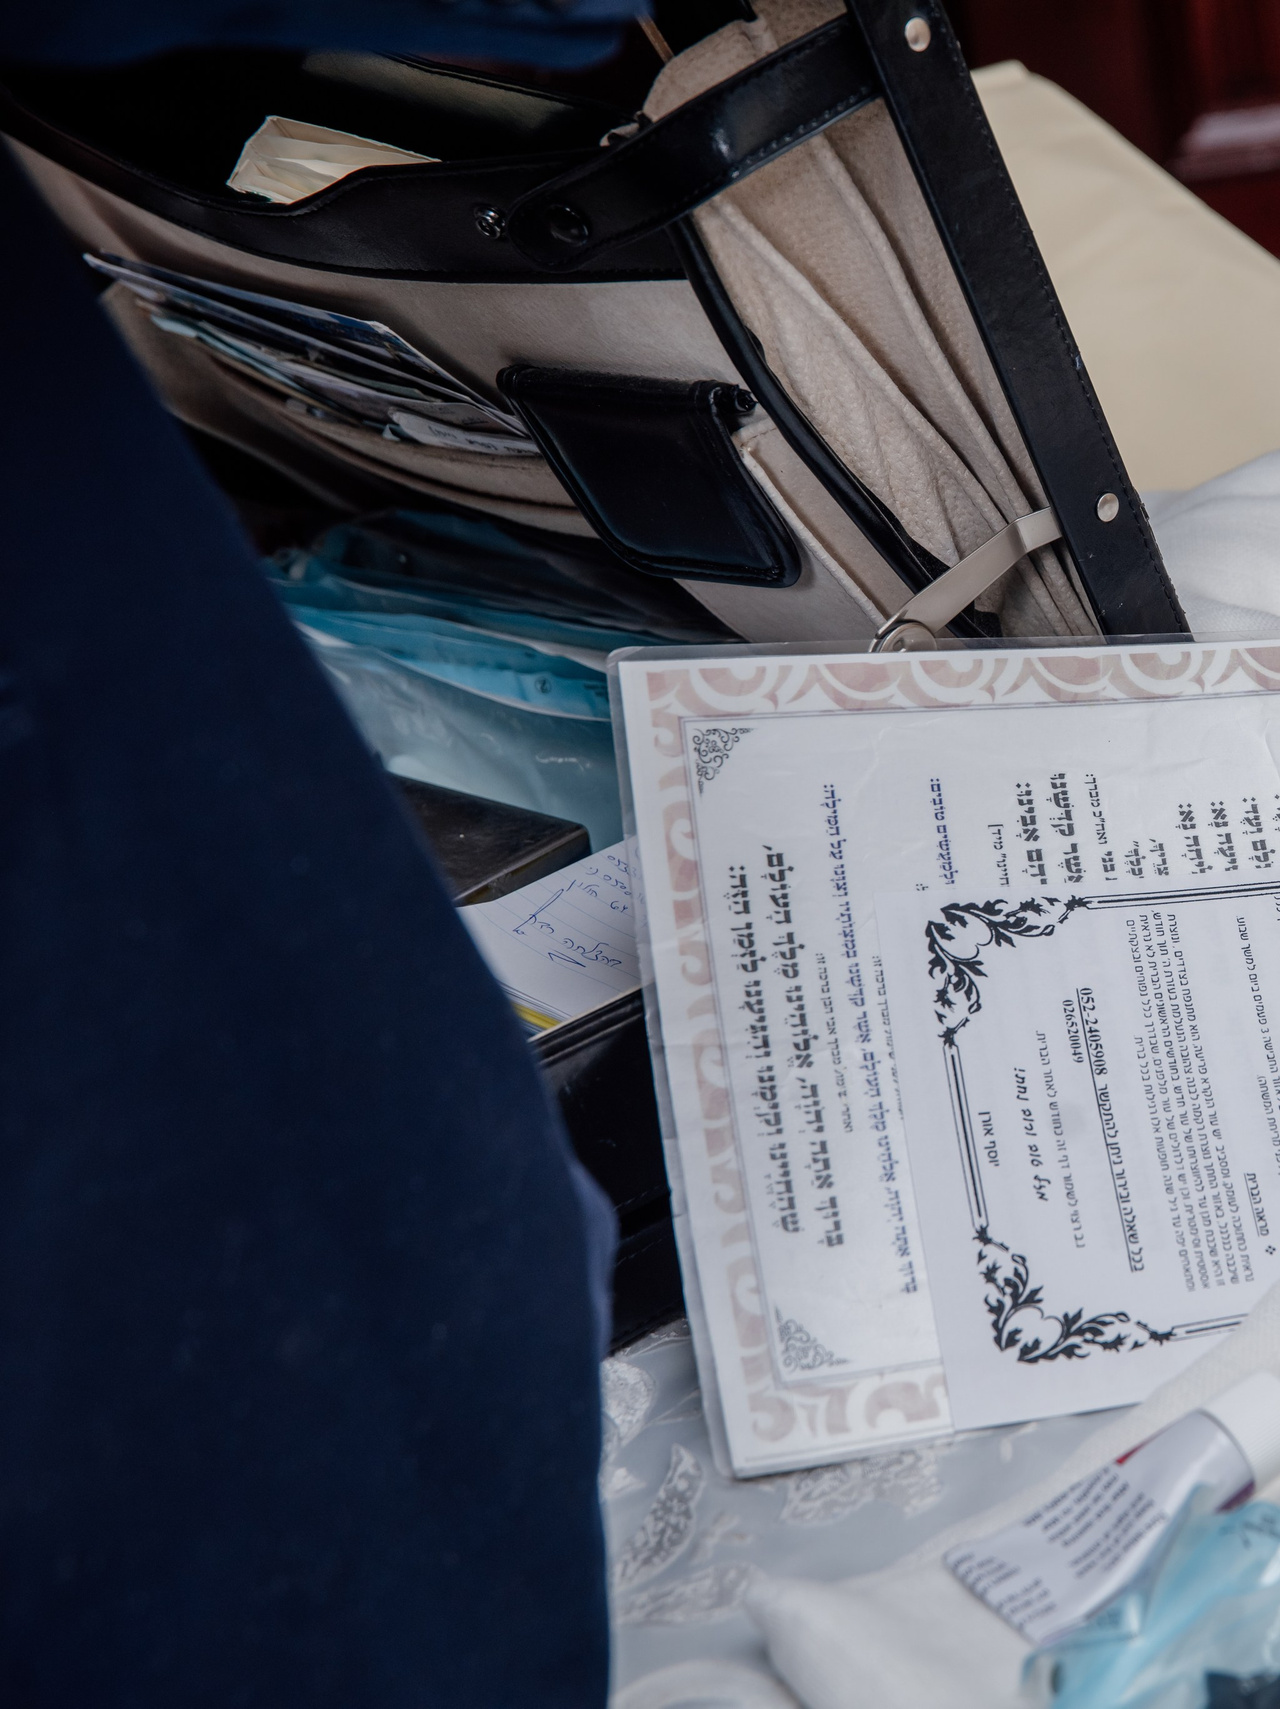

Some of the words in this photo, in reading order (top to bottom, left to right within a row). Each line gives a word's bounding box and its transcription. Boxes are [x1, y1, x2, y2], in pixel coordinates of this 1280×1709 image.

[1240, 942, 1256, 971] למשך
[1247, 972, 1260, 992] ביום
[1252, 993, 1268, 1025] פעמים
[1061, 998, 1084, 1063] 026520049
[1075, 986, 1108, 1076] 052-2405908
[1262, 1035, 1279, 1073] החבישה
[1042, 1068, 1058, 1098] לאחר
[977, 1110, 994, 1136] אורן
[1048, 1100, 1064, 1136] כחודש
[1096, 1083, 1119, 1138] להתקשר
[983, 1139, 1000, 1167] יוסף
[1055, 1138, 1067, 1151] זה
[1106, 1141, 1123, 1165] ניתן
[1057, 1153, 1070, 1169] דף
[1062, 1172, 1078, 1207] לשמור
[1113, 1167, 1131, 1203] ובירור
[1242, 1172, 1262, 1205] הברית
[1069, 1208, 1082, 1231] רצוי
[1120, 1206, 1139, 1244] שאלה
[1250, 1205, 1269, 1236] מראה
[1129, 1246, 1144, 1271] בכל
